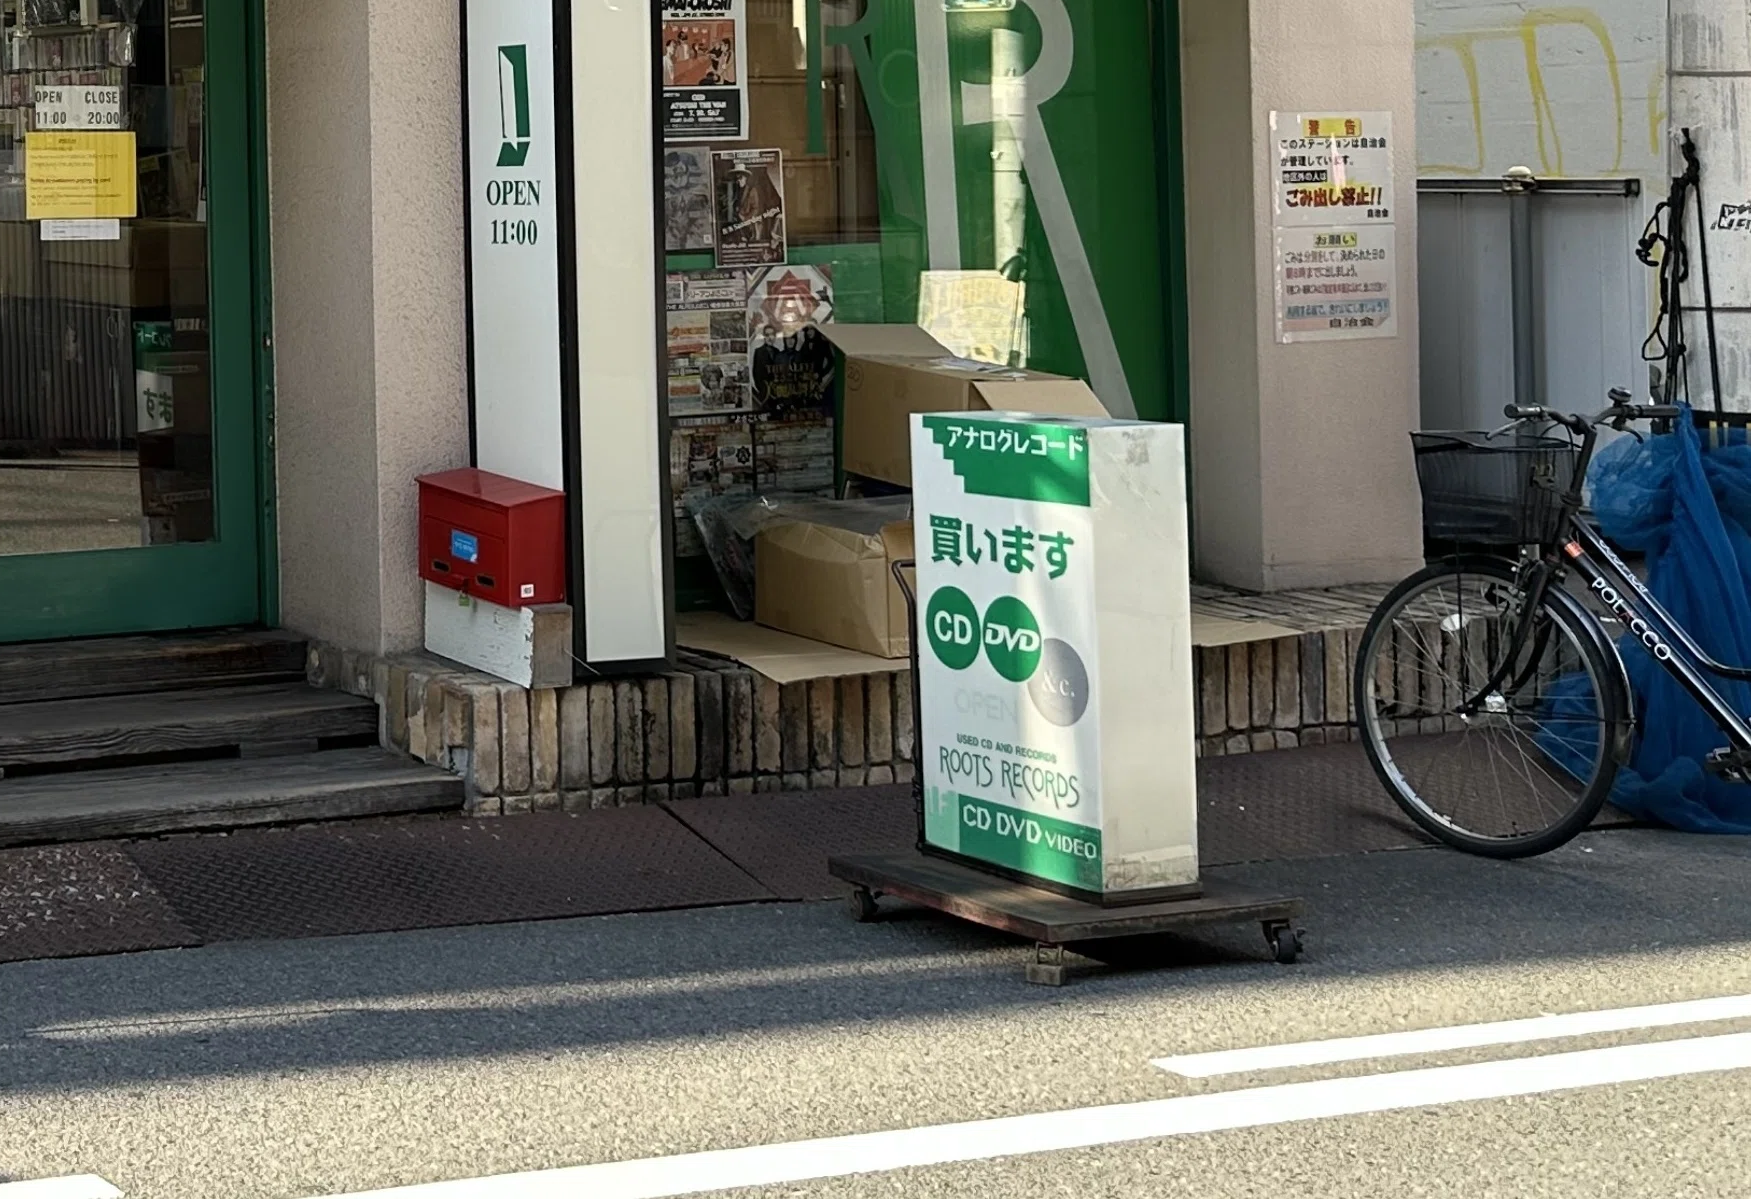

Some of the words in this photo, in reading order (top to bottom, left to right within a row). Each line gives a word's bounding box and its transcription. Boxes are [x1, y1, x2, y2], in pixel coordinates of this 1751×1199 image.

[35, 91, 63, 103] OPEN
[84, 91, 118, 104] CLOSE
[36, 112, 67, 124] 11:00
[88, 112, 119, 124] 20:00
[486, 180, 541, 206] OPEN
[491, 219, 538, 245] 11:00
[947, 426, 1084, 461] アナログレコード
[930, 513, 1075, 580] 買います
[934, 610, 973, 645] CD
[985, 622, 1040, 652] DVD
[1592, 577, 1672, 662] POLACCO
[956, 733, 979, 746] USED
[981, 738, 993, 749] CD
[996, 741, 1013, 754] AND
[1015, 745, 1057, 764] RECORDS
[939, 746, 993, 788] ROOTS
[1001, 760, 1080, 810] RECORDS
[963, 804, 992, 831] CD
[996, 811, 1042, 844] DVD
[1045, 830, 1097, 859] VIDEO
